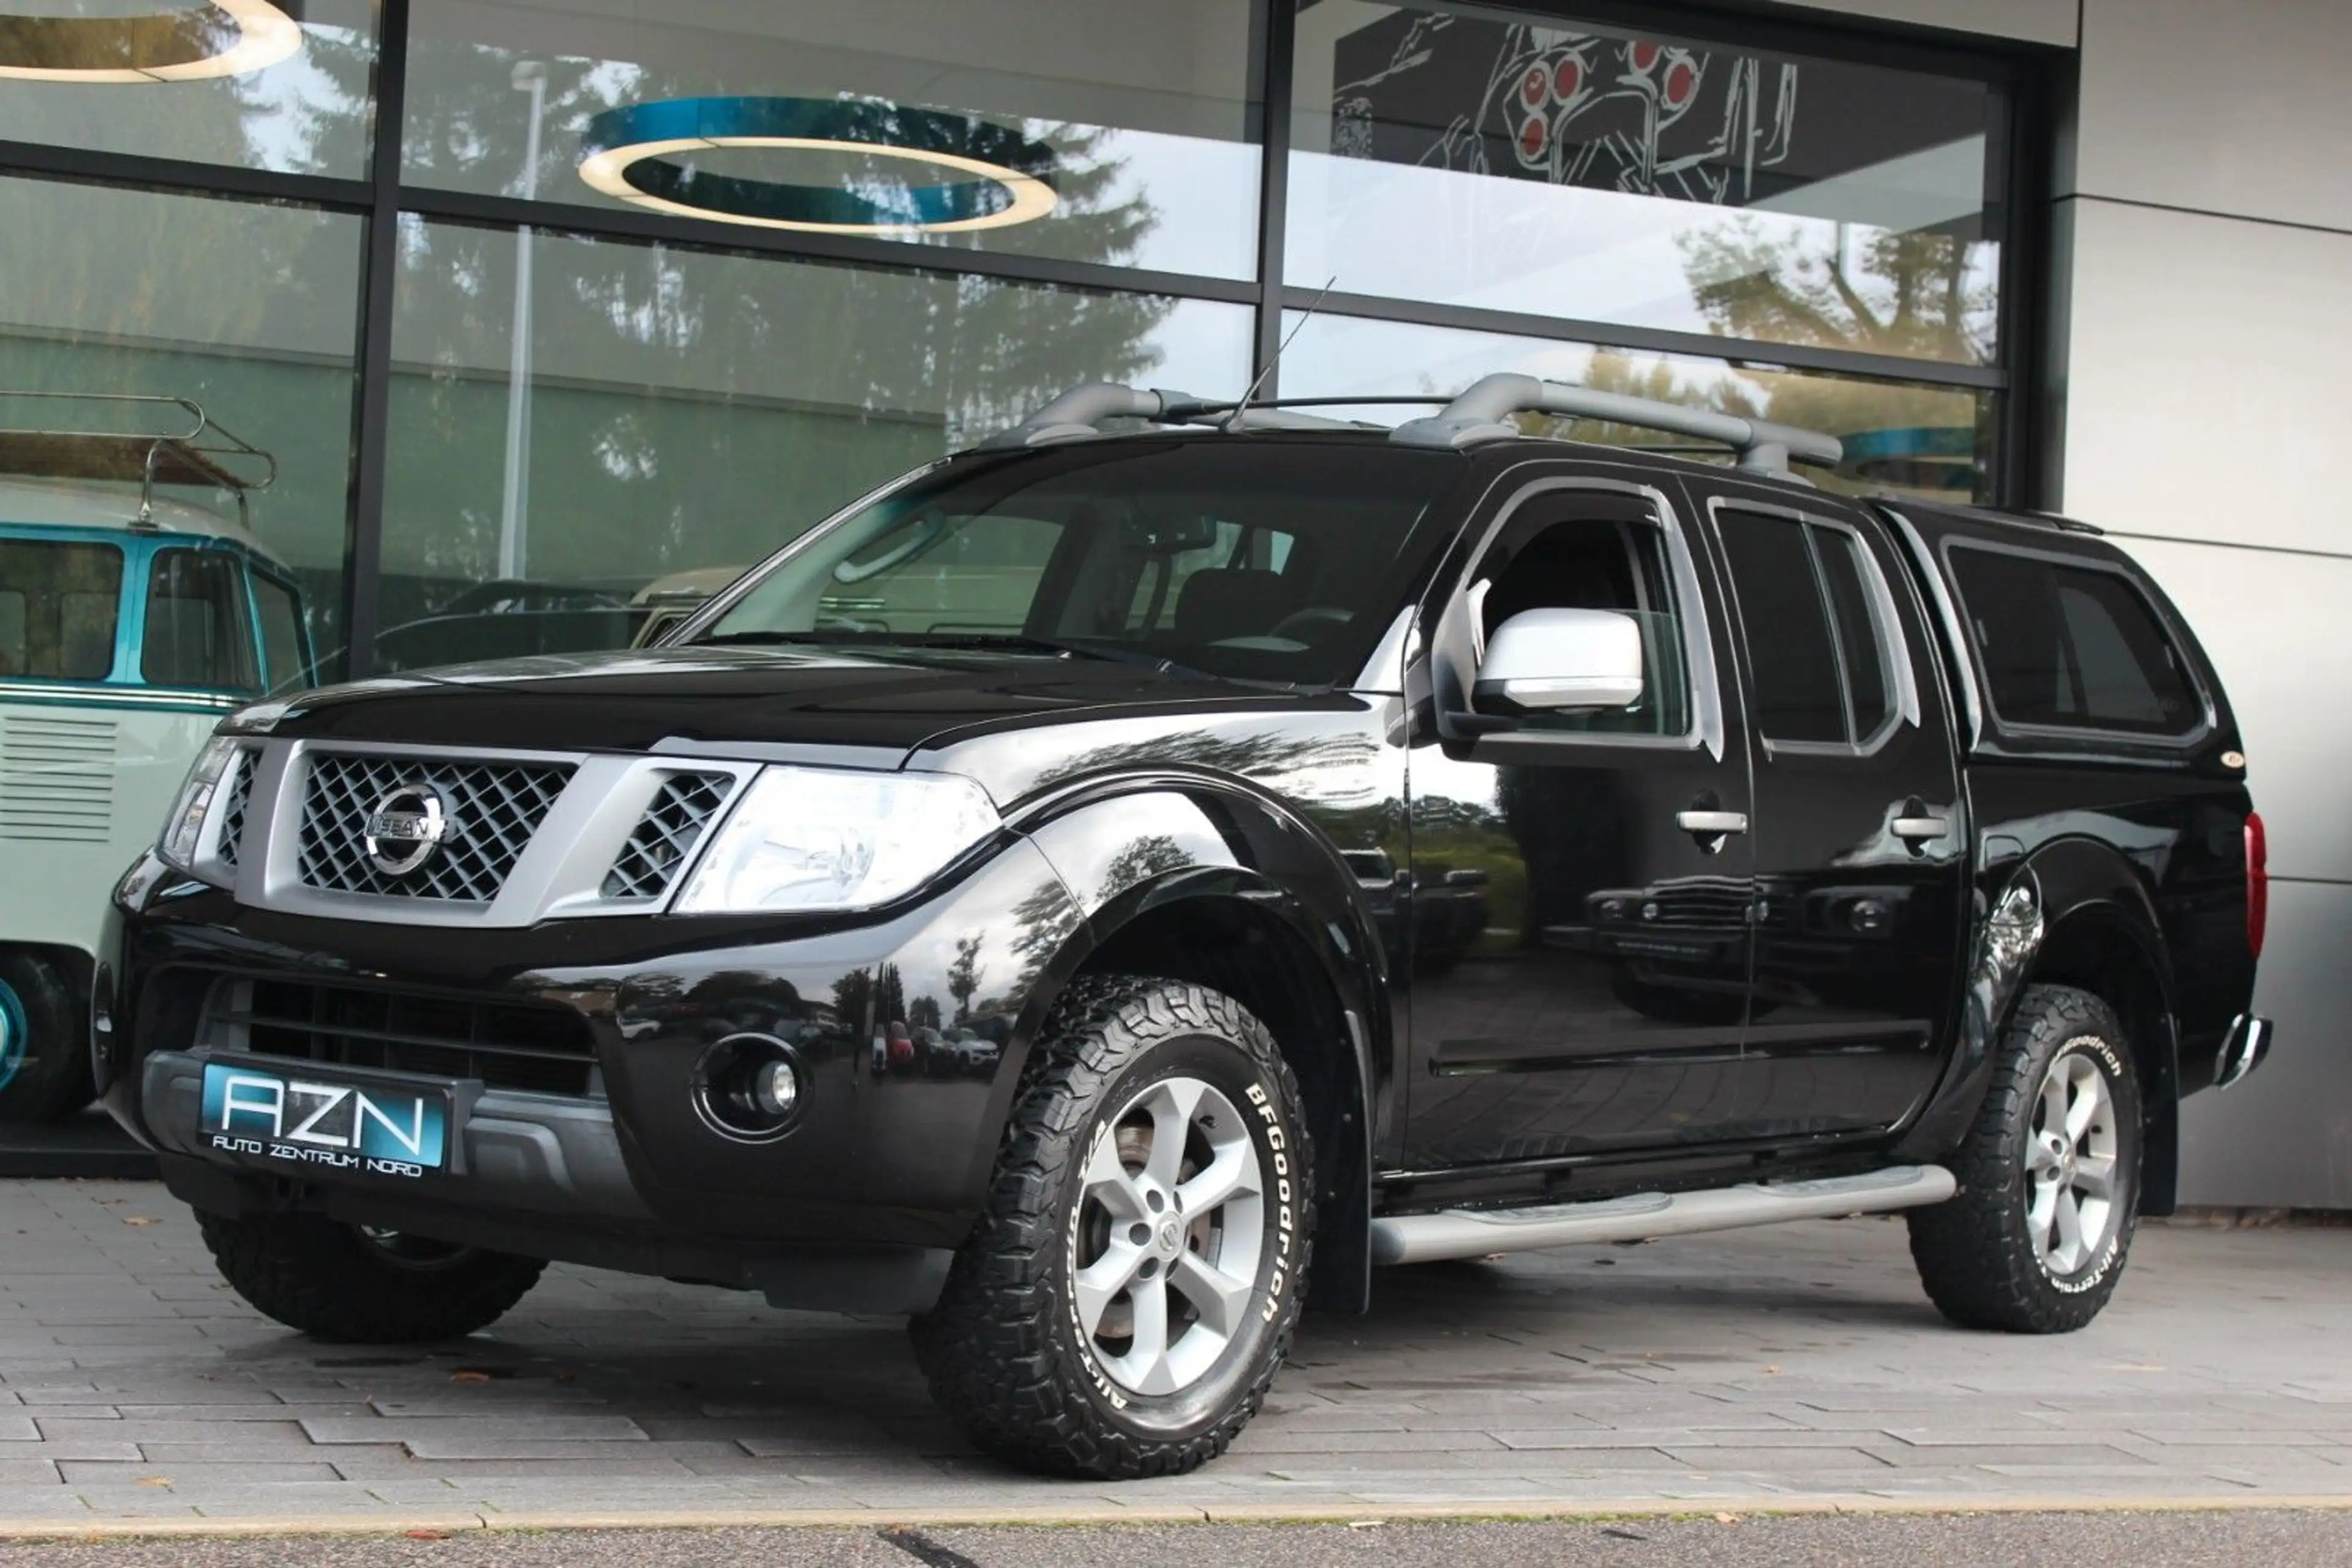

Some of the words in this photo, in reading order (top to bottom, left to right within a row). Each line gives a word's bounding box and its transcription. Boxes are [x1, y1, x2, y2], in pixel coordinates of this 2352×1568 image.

[222, 1075, 423, 1156] AZN
[213, 1136, 262, 1154] AUTO
[270, 1143, 359, 1168] ZENTRUM
[367, 1159, 423, 1178] NORD
[1245, 1082, 1293, 1323] BFGoodrich
